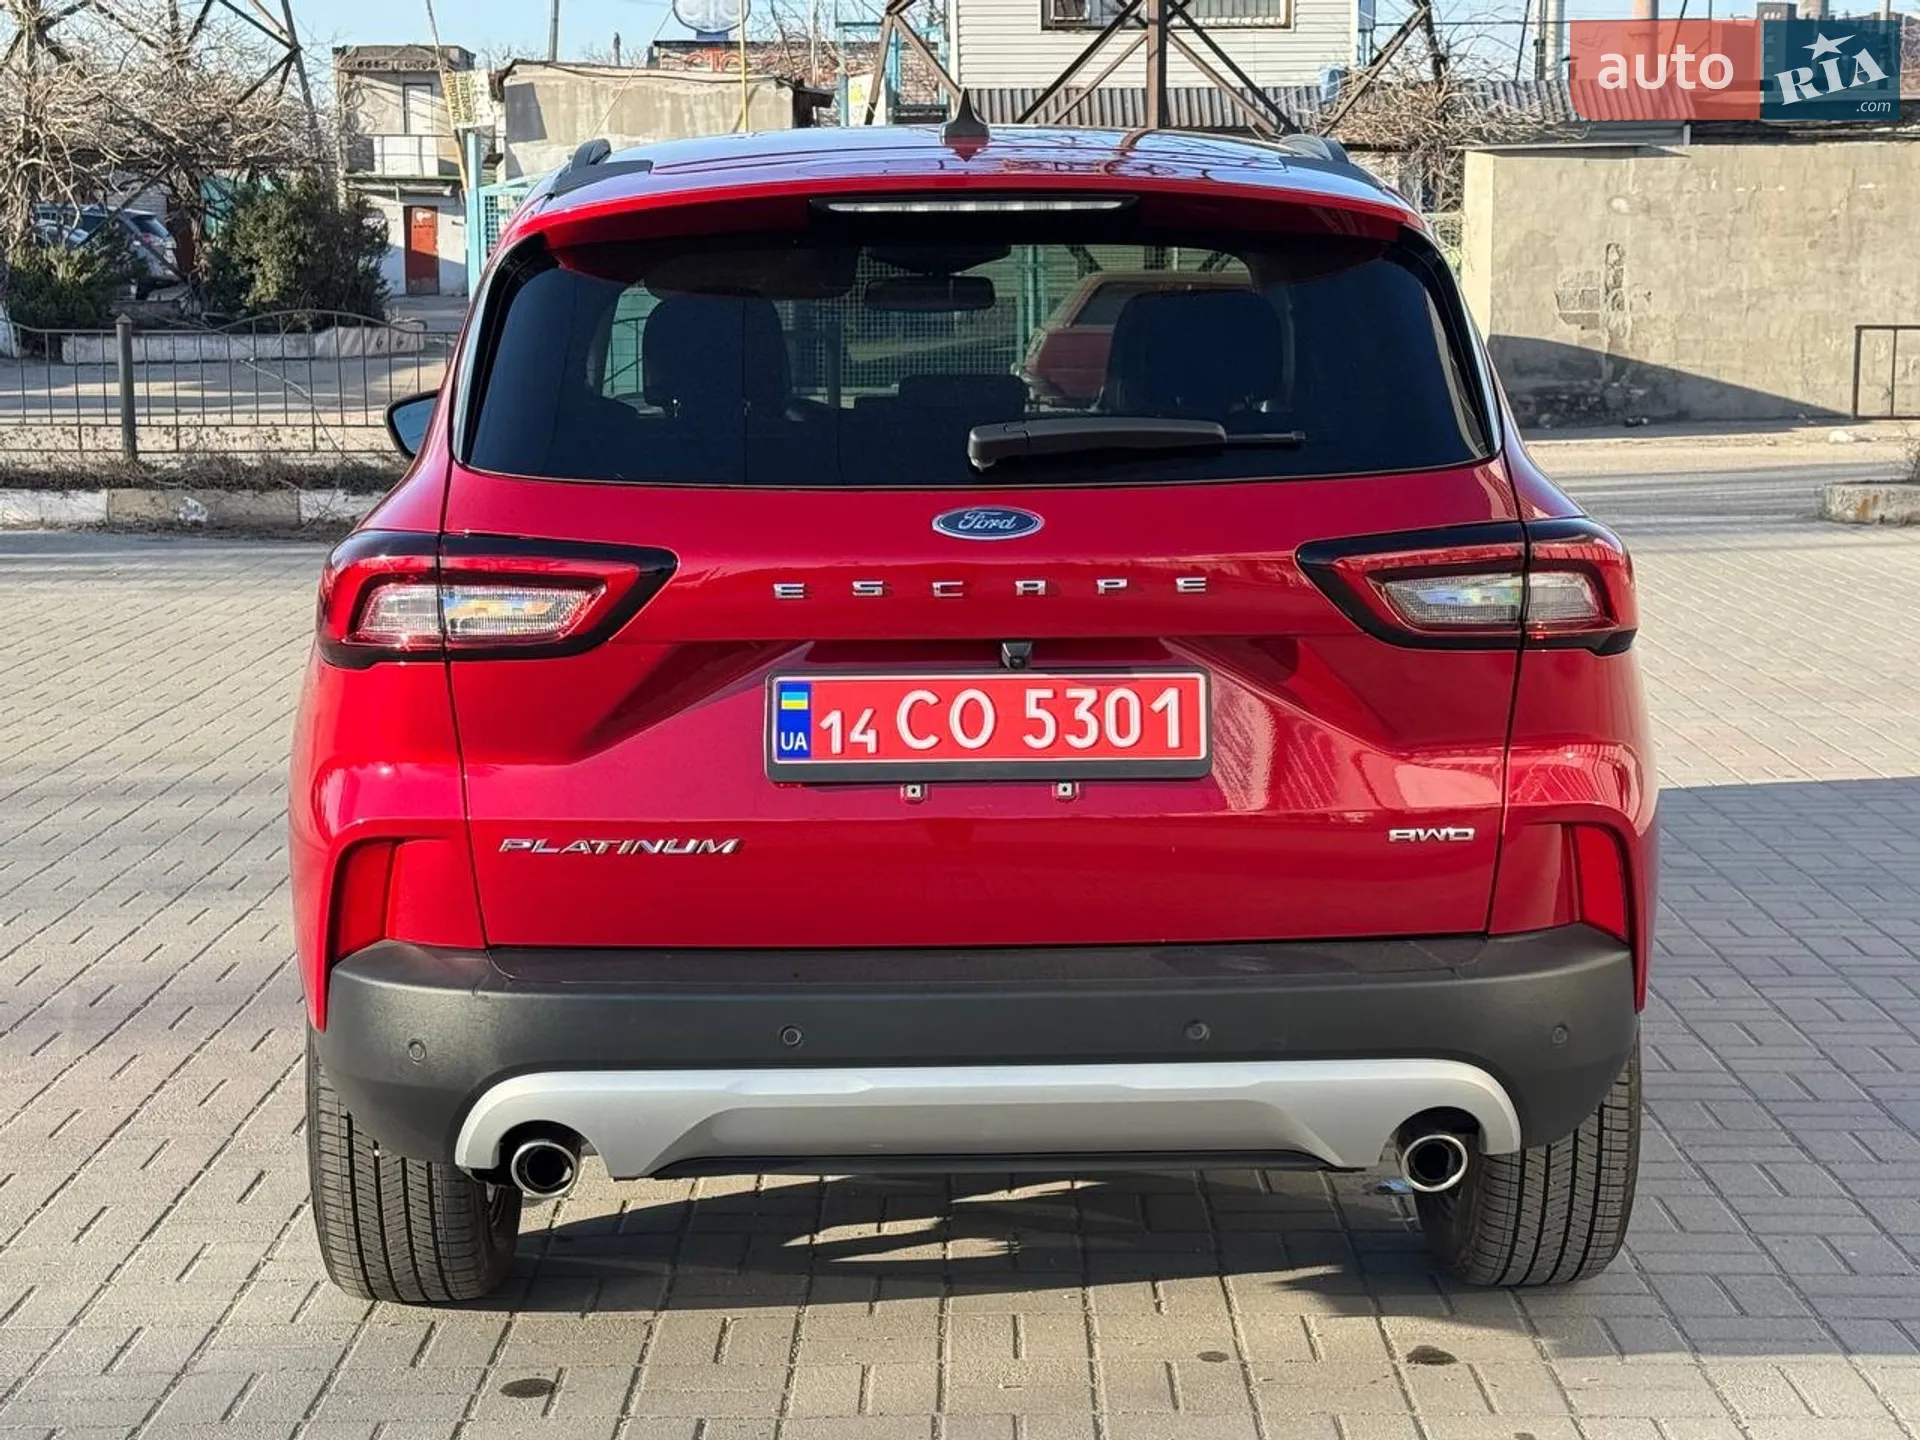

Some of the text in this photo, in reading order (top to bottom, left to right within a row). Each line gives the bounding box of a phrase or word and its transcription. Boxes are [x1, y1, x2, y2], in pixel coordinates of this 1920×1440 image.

[958, 511, 1017, 529] Ford
[773, 576, 1208, 599] ESCAPE
[819, 686, 1182, 755] 14 CO 5301
[780, 732, 808, 751] UA
[1389, 827, 1475, 842] AWD
[499, 838, 740, 855] PLATINUM
